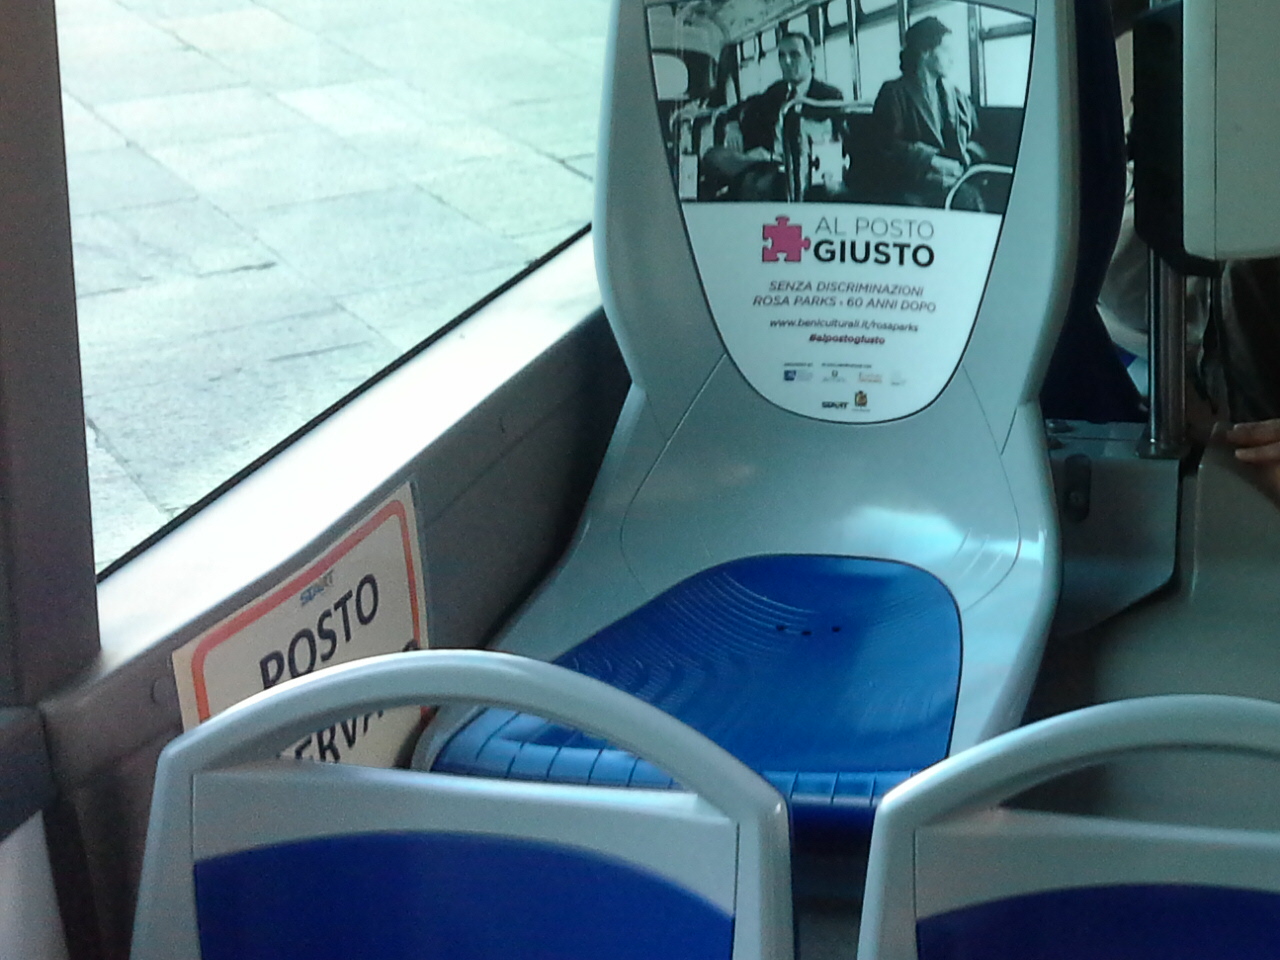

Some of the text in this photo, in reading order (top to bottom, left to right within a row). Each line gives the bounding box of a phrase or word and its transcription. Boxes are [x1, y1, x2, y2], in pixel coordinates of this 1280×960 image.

[814, 216, 935, 240] AL POSTO
[813, 239, 936, 268] GIUSTO
[769, 280, 925, 297] SENZA DISCRIMINAZIONI
[753, 294, 790, 307] ROSA
[793, 295, 836, 307] PARKS
[846, 296, 863, 308] 60
[865, 297, 898, 310] ANNI
[900, 299, 937, 314] DOPO
[260, 573, 379, 691] POSTO
